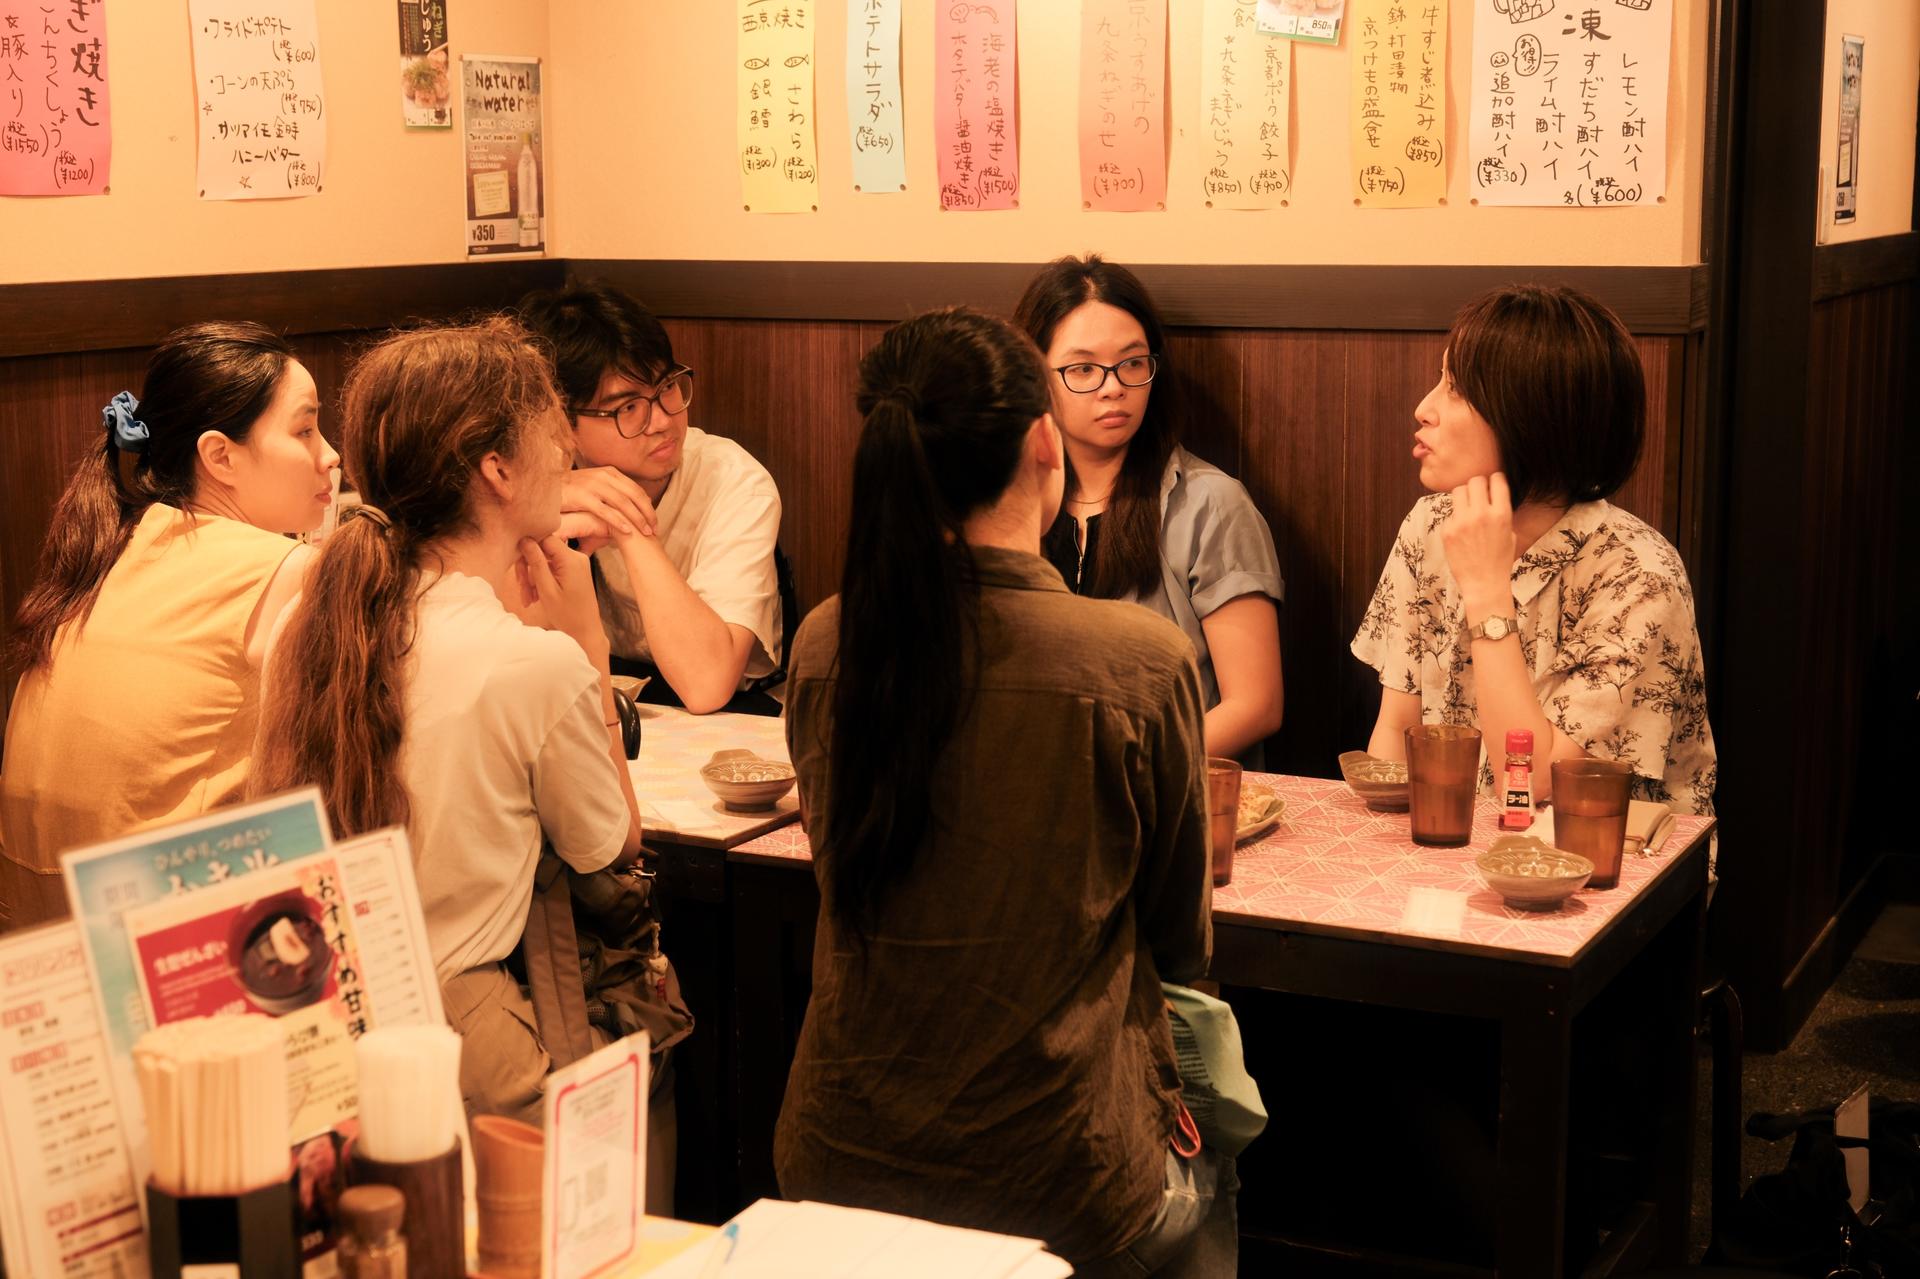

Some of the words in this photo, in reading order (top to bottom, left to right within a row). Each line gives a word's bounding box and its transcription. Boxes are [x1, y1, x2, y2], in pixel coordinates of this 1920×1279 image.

[742, 6, 805, 32] 西京焼き
[1562, 8, 1612, 41] 凍
[1, 34, 29, 117] 豚入り
[67, 0, 104, 126] ぎ焼き
[475, 69, 530, 92] Natural
[483, 93, 525, 113] water
[750, 79, 772, 130] 銀鱈
[982, 33, 1005, 161] 海老の塩焼き
[1260, 45, 1284, 160] 京都ポーク餃子
[1415, 5, 1440, 131] 牛すじ煮込み
[787, 84, 805, 149] さわら
[1490, 71, 1516, 158] 追加酎ハイ
[1536, 54, 1566, 181] ライム酎ハイ
[1577, 52, 1604, 180] すだち酎ハイ
[1621, 53, 1646, 172] レモン酎ハイ
[232, 146, 300, 164] ハニーバター
[472, 224, 496, 241] ¥350
